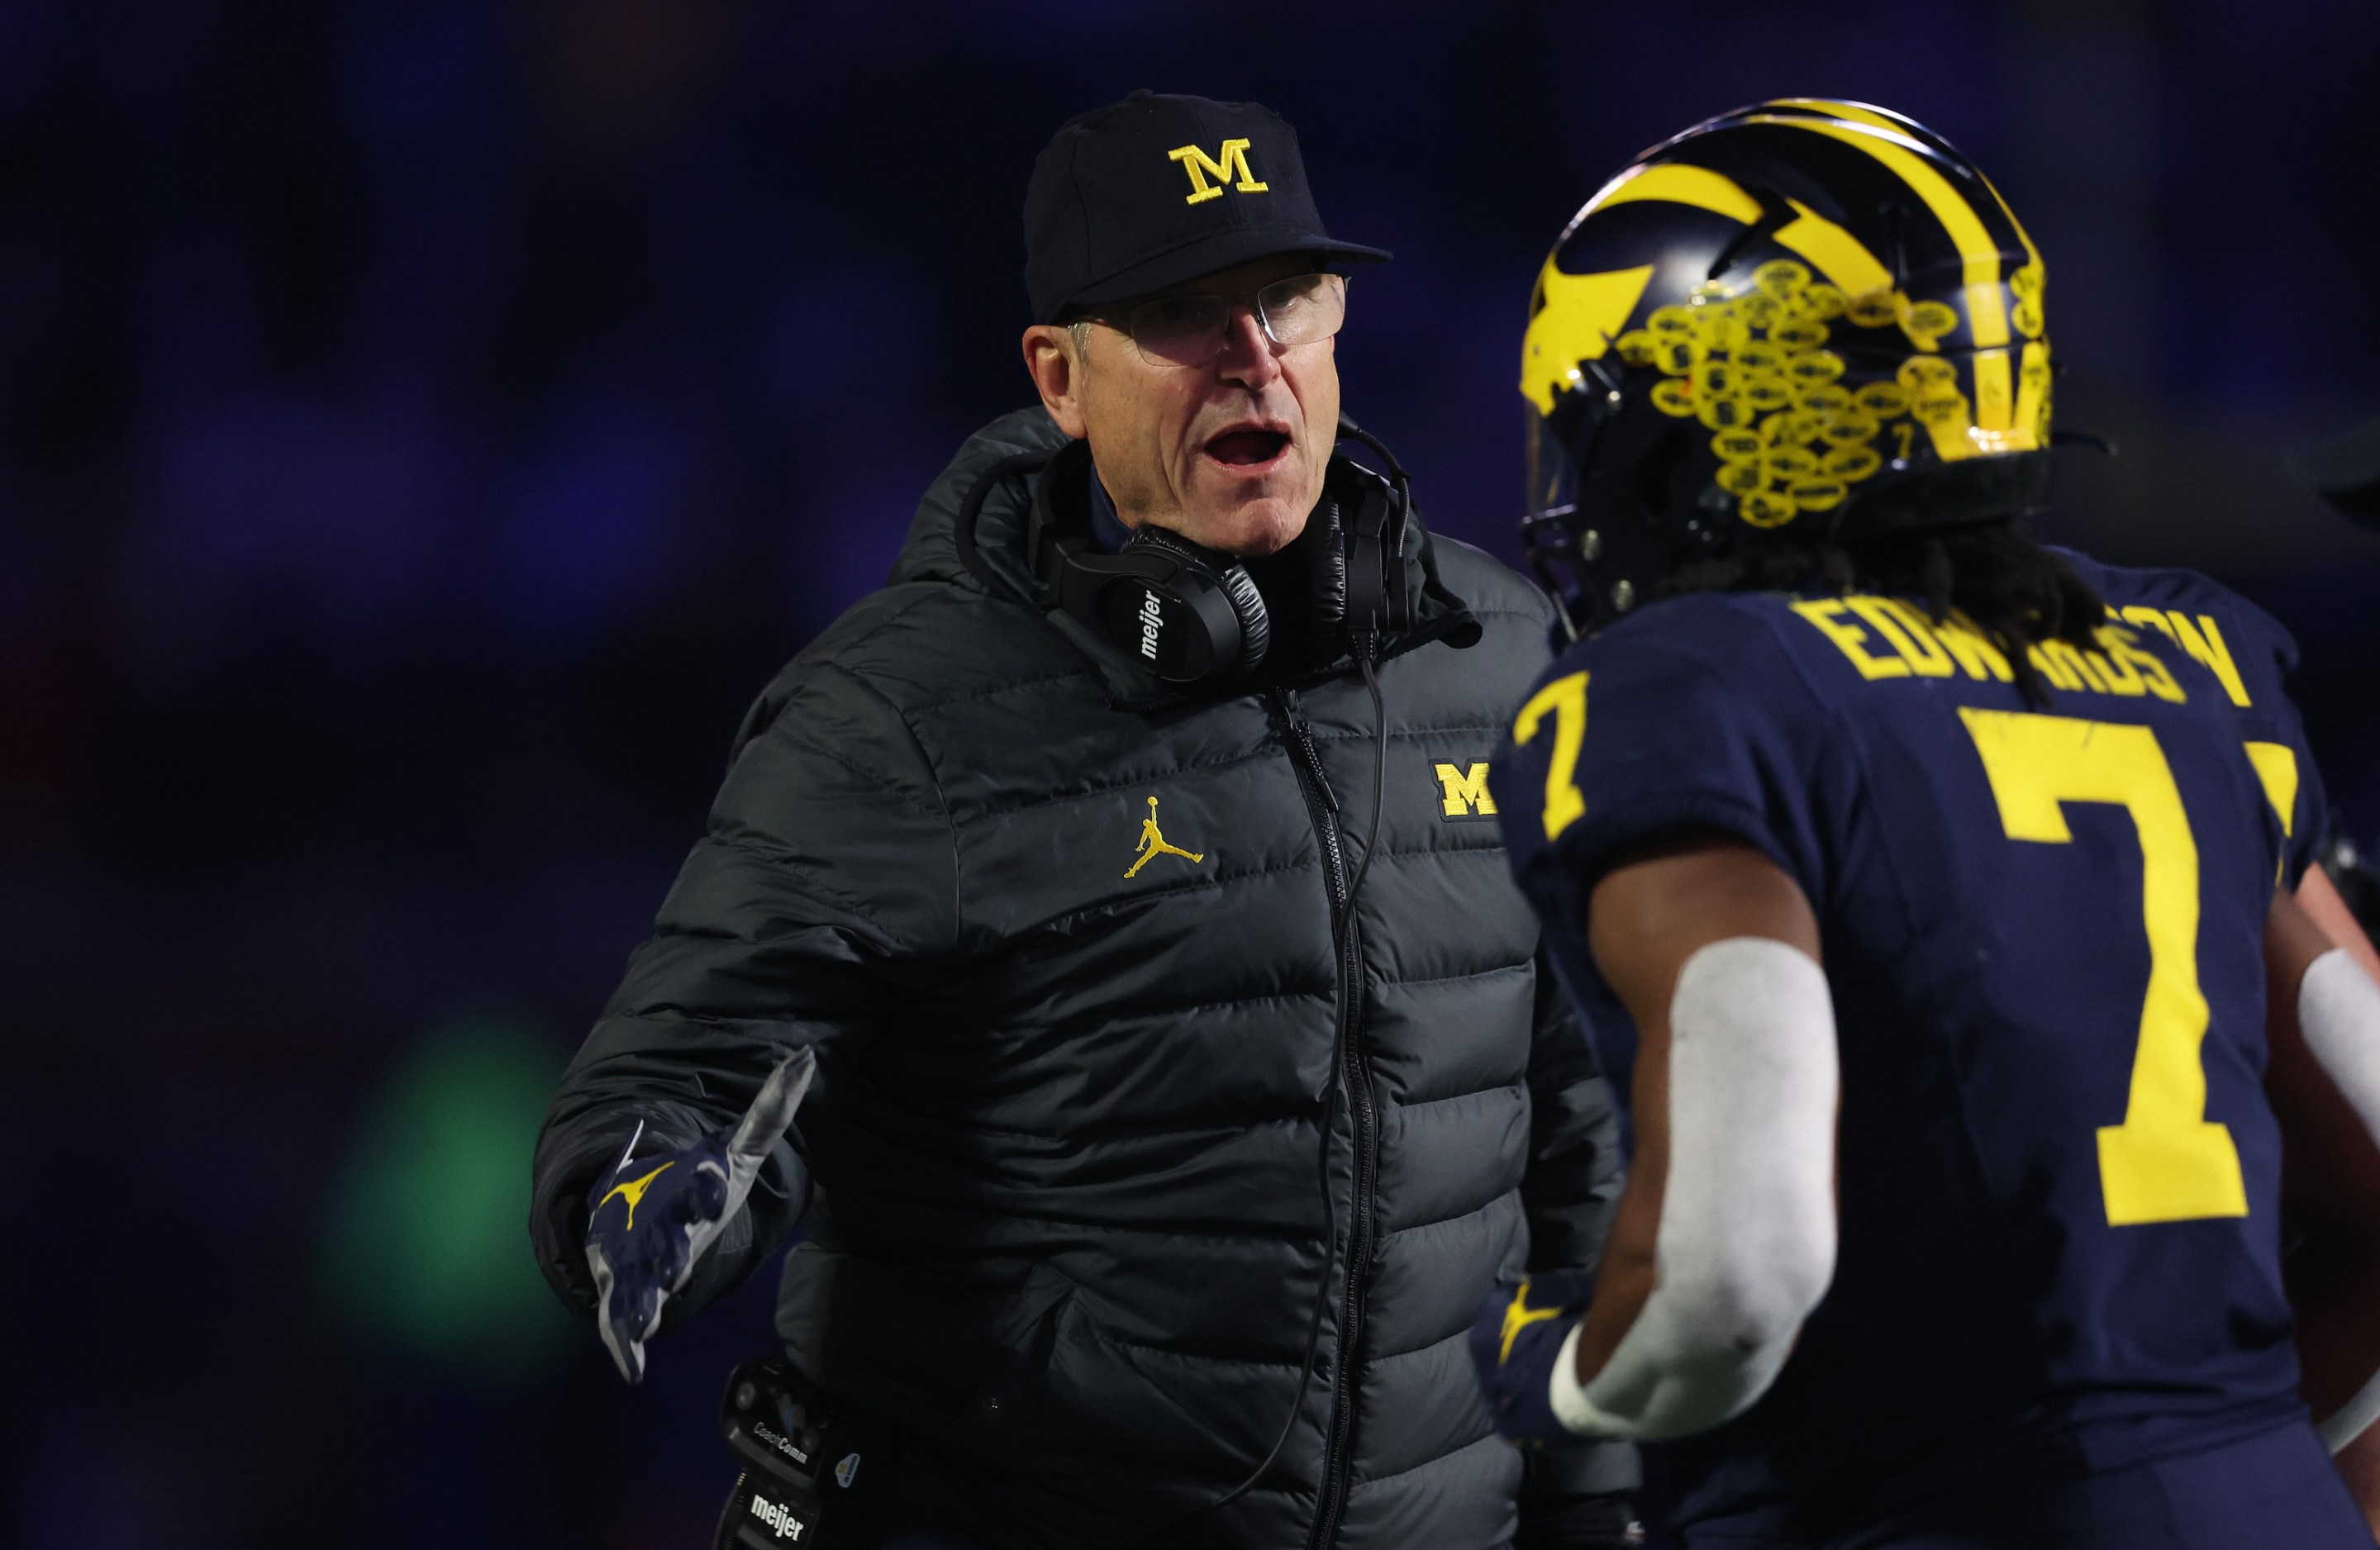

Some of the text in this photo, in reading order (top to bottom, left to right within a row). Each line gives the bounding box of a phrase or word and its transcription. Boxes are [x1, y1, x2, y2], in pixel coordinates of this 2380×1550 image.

[1168, 137, 1269, 205] M
[1139, 590, 1164, 659] meijer
[1435, 763, 1498, 816] M
[1513, 670, 1591, 843] 7
[1958, 706, 2249, 1227] 7
[750, 1494, 804, 1542] meijer
